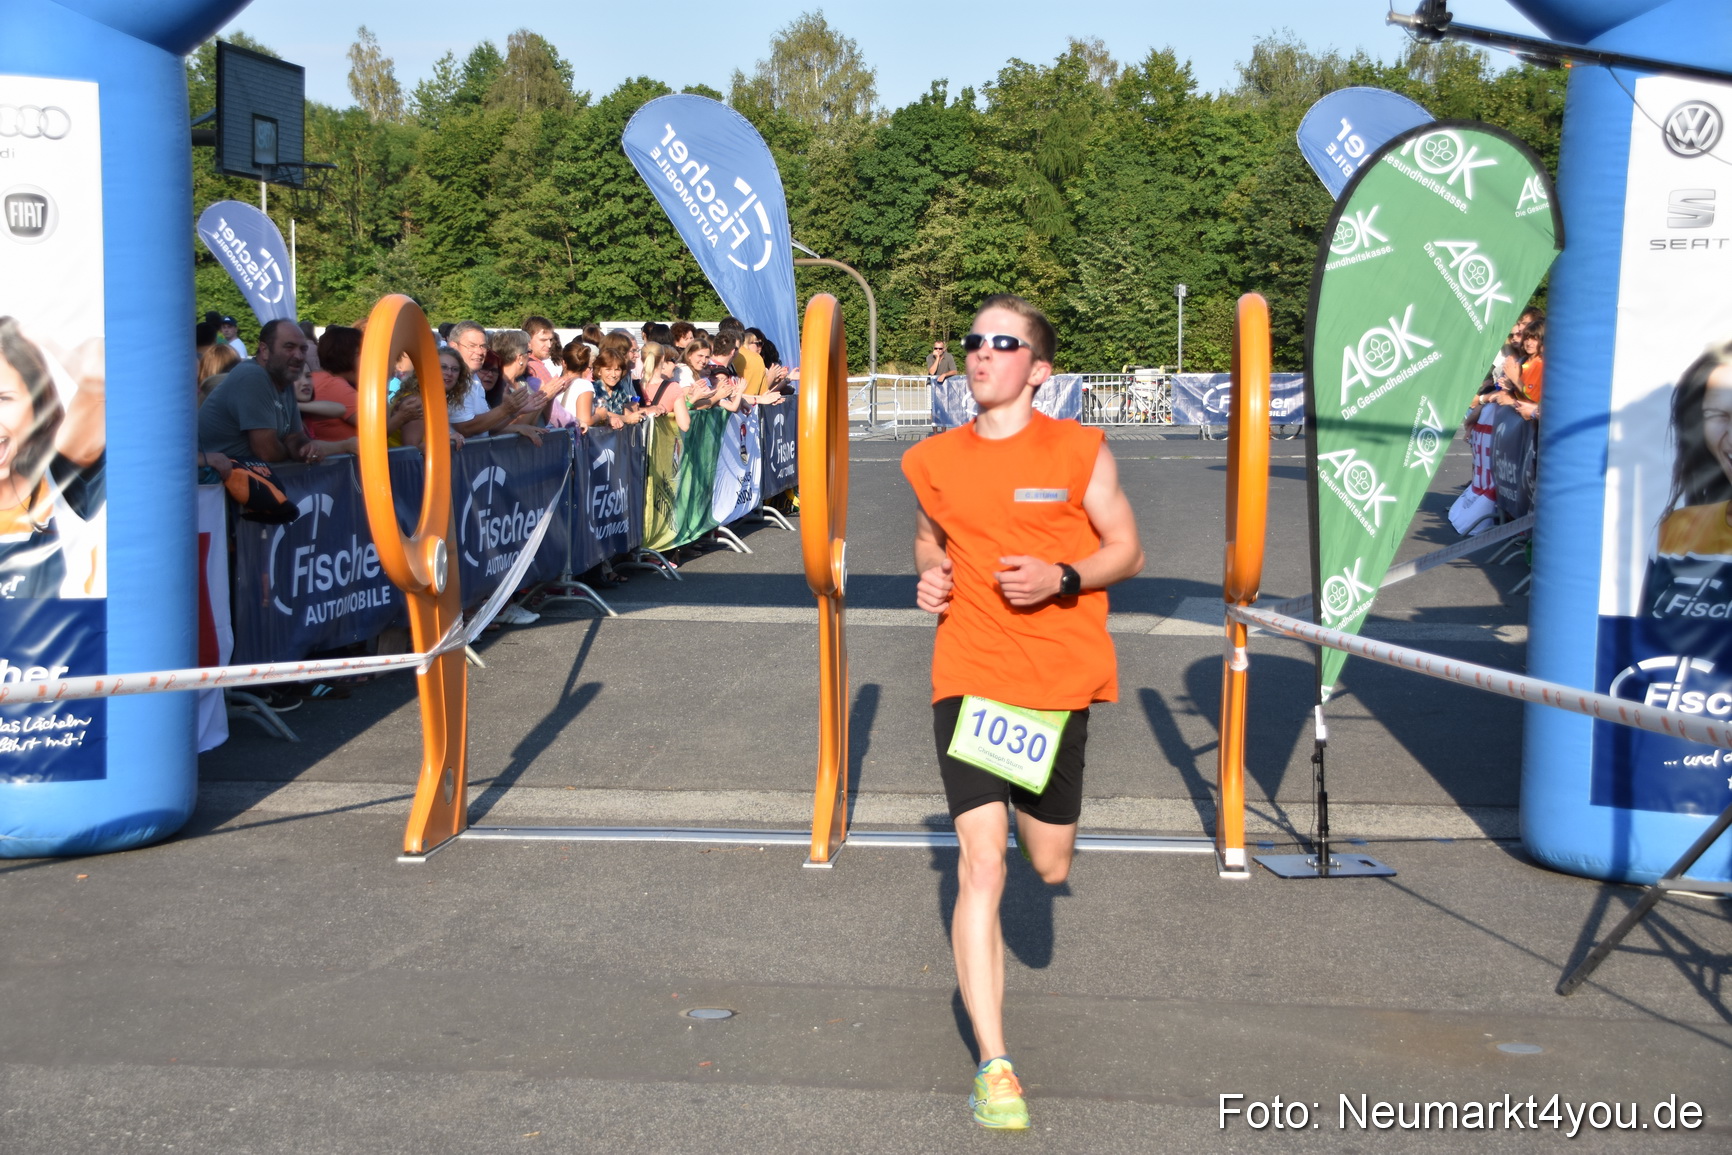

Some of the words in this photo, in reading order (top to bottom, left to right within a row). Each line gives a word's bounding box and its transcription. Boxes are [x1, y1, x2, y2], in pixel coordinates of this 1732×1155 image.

[9, 201, 45, 228] FIAT
[1329, 205, 1389, 256] OK
[1323, 246, 1394, 272] sundheitskasse.
[1423, 242, 1435, 259] Die
[1650, 238, 1729, 250] SEAT
[1433, 240, 1513, 325] AOK
[1340, 303, 1434, 406] AOK
[1341, 404, 1358, 421] Die
[1356, 350, 1442, 409] Gesundheitskasse.
[1409, 400, 1443, 478] AOK
[1317, 448, 1398, 529] AOK
[1319, 469, 1377, 538] Gesundheitskasse.
[292, 534, 382, 597] Fische
[305, 585, 391, 627] AUTOMOBILE
[972, 708, 1047, 762] 1030
